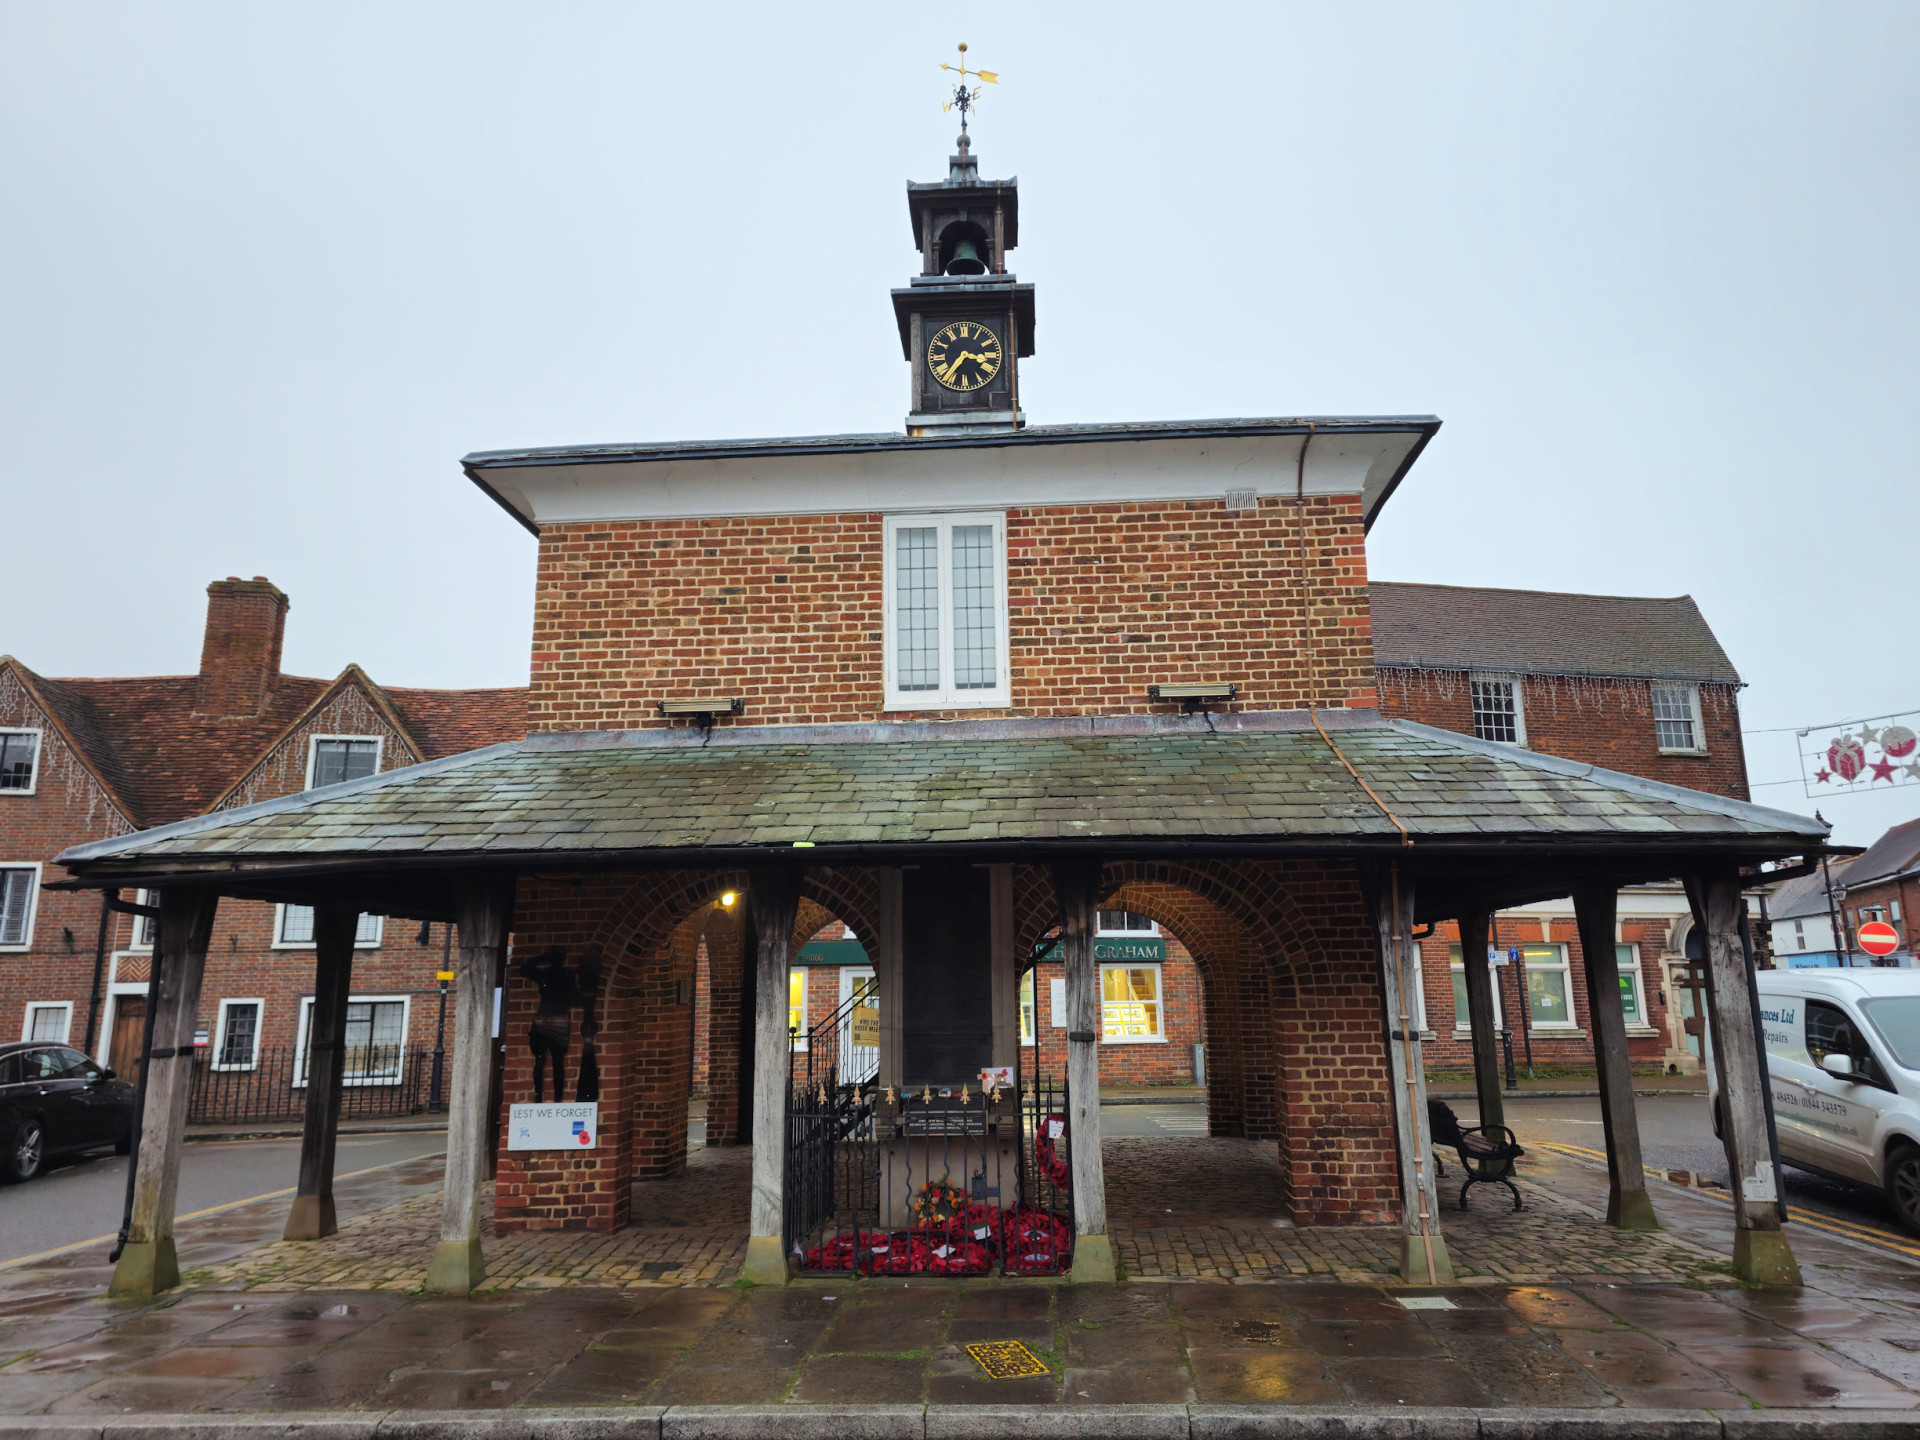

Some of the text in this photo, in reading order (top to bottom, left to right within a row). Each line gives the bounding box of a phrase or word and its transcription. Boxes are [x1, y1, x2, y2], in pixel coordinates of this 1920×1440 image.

[973, 86, 982, 100] E
[1094, 944, 1159, 959] GRAHAM
[1781, 1008, 1795, 1024] Ltd
[1762, 1028, 1788, 1044] Repairs
[514, 1108, 593, 1118] LEST WE FORGET
